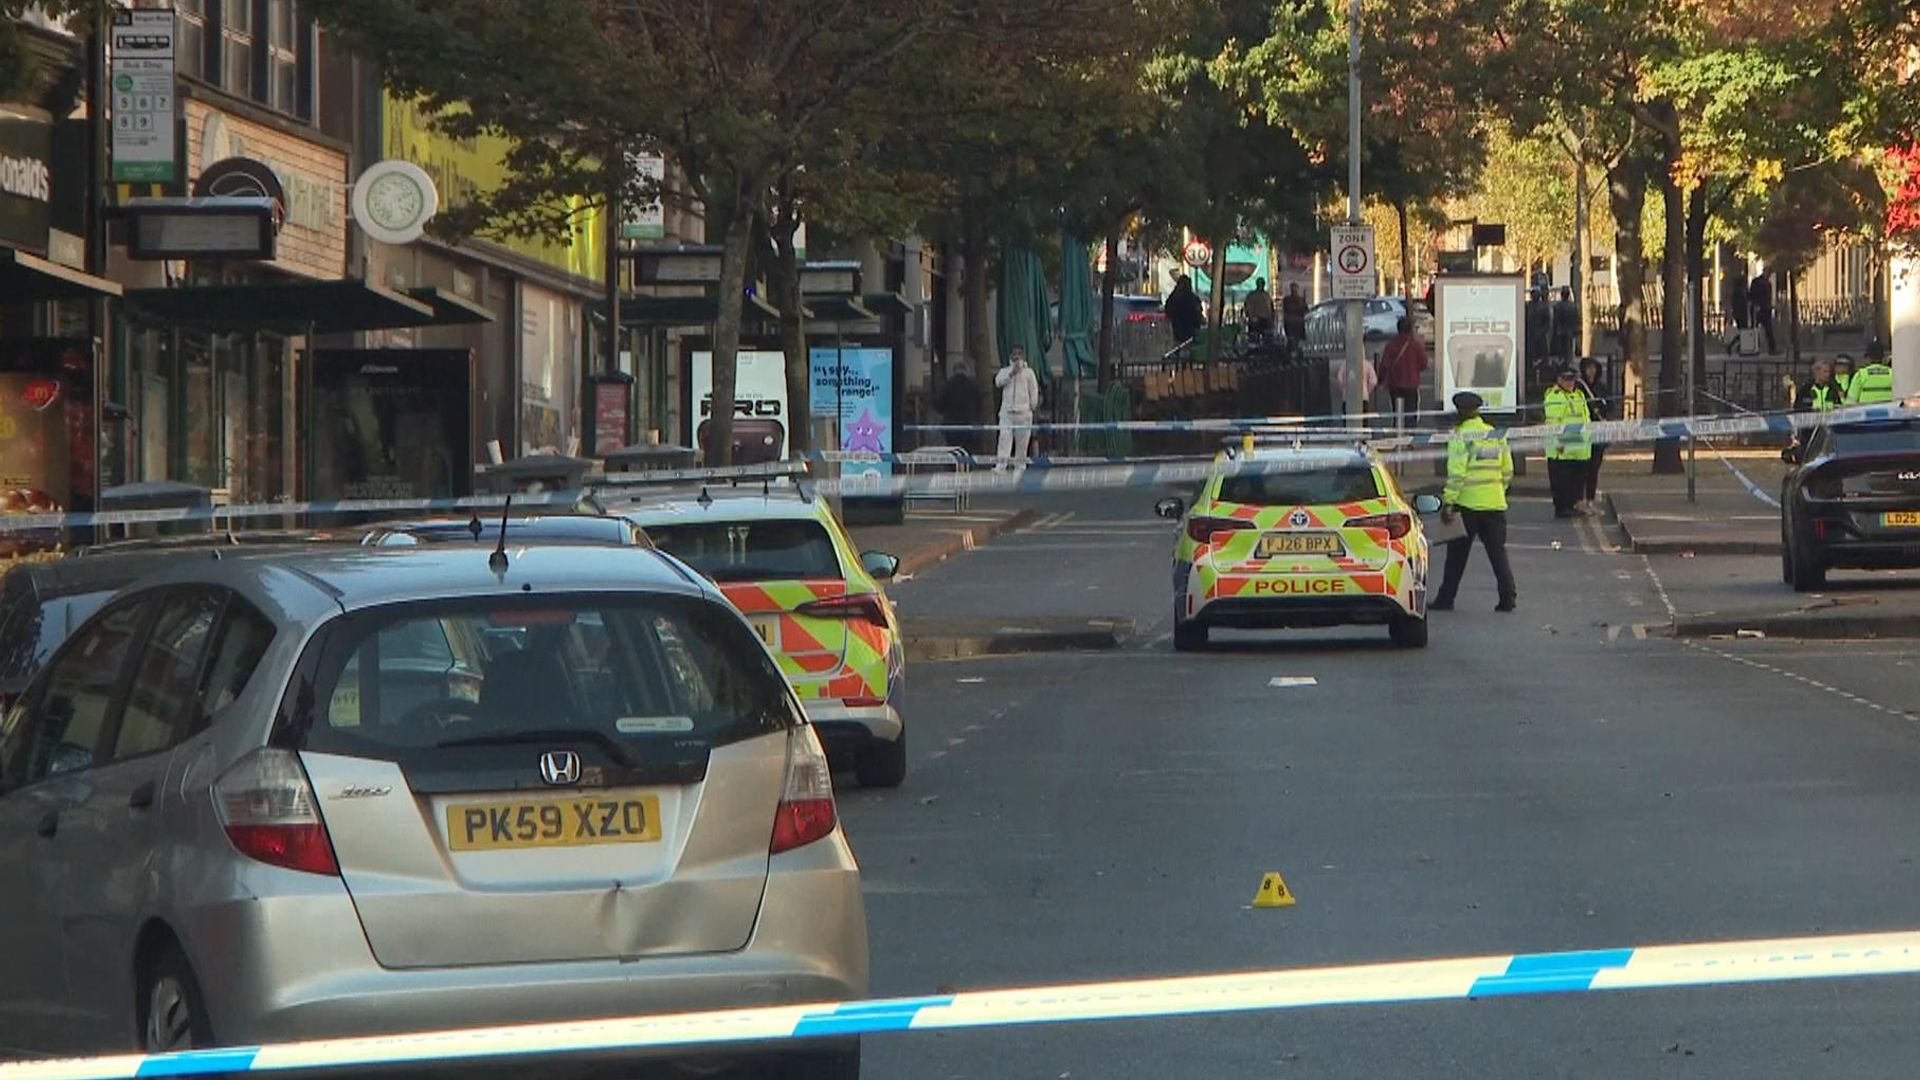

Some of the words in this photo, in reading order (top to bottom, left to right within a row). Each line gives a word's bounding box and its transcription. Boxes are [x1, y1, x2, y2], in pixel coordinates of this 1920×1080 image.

[1338, 234, 1365, 243] ZONE
[1189, 248, 1206, 261] 30
[1449, 321, 1510, 333] PRO
[1887, 514, 1917, 524] LD25
[1266, 537, 1302, 551] FJ26
[1305, 537, 1332, 550] BPX
[1255, 579, 1345, 593] POLICE
[465, 805, 563, 843] PK59
[573, 801, 646, 837] XZO
